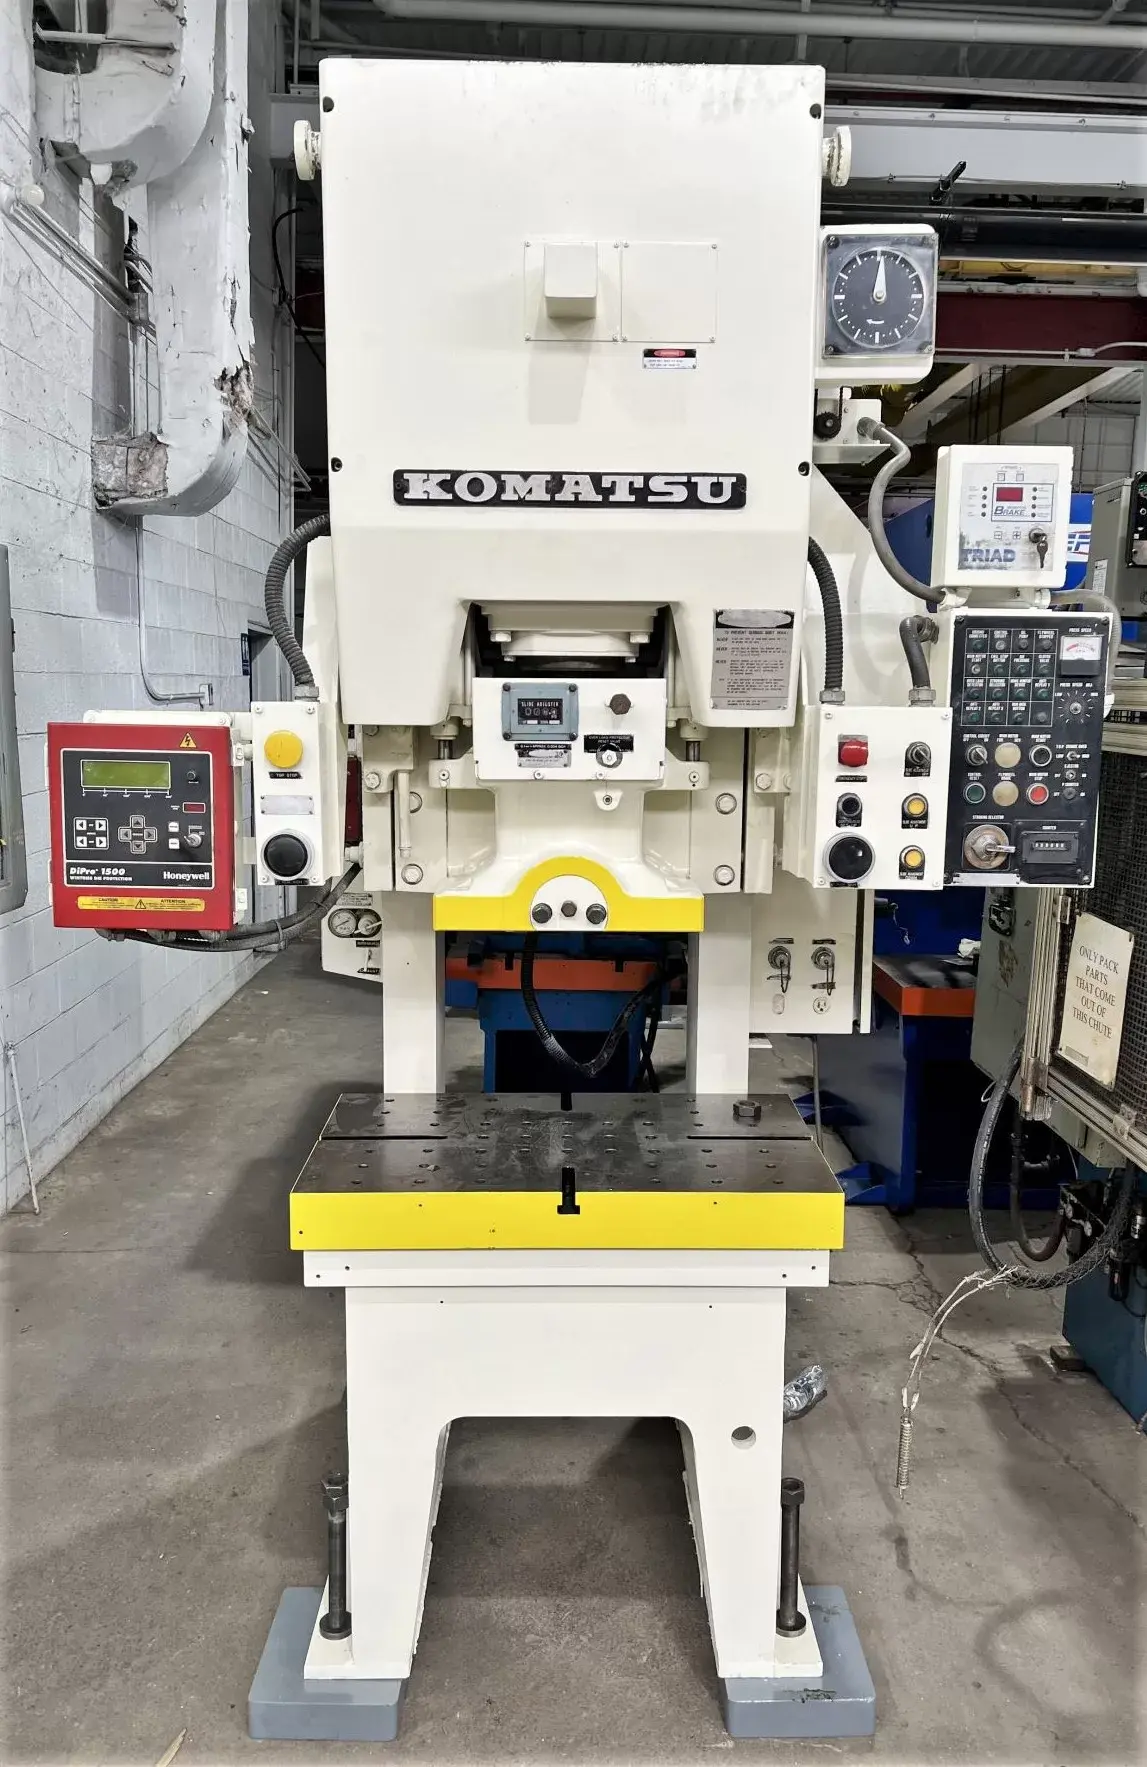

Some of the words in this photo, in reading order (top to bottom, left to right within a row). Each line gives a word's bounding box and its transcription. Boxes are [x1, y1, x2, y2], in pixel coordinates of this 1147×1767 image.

[403, 472, 738, 504] KOMATSU
[961, 548, 1017, 563] TRIAD
[101, 867, 126, 876] 1500
[163, 871, 210, 882] Honeywell
[1079, 945, 1099, 963] ONLY
[1099, 955, 1120, 974] PACK
[1085, 965, 1108, 986] PARTS
[1075, 975, 1095, 995] THAT
[1094, 986, 1116, 1007] COME
[1081, 995, 1096, 1013] OUT
[1096, 1004, 1107, 1018] OF
[1072, 1006, 1089, 1025] THIS
[1088, 1017, 1113, 1039] CHUTE
